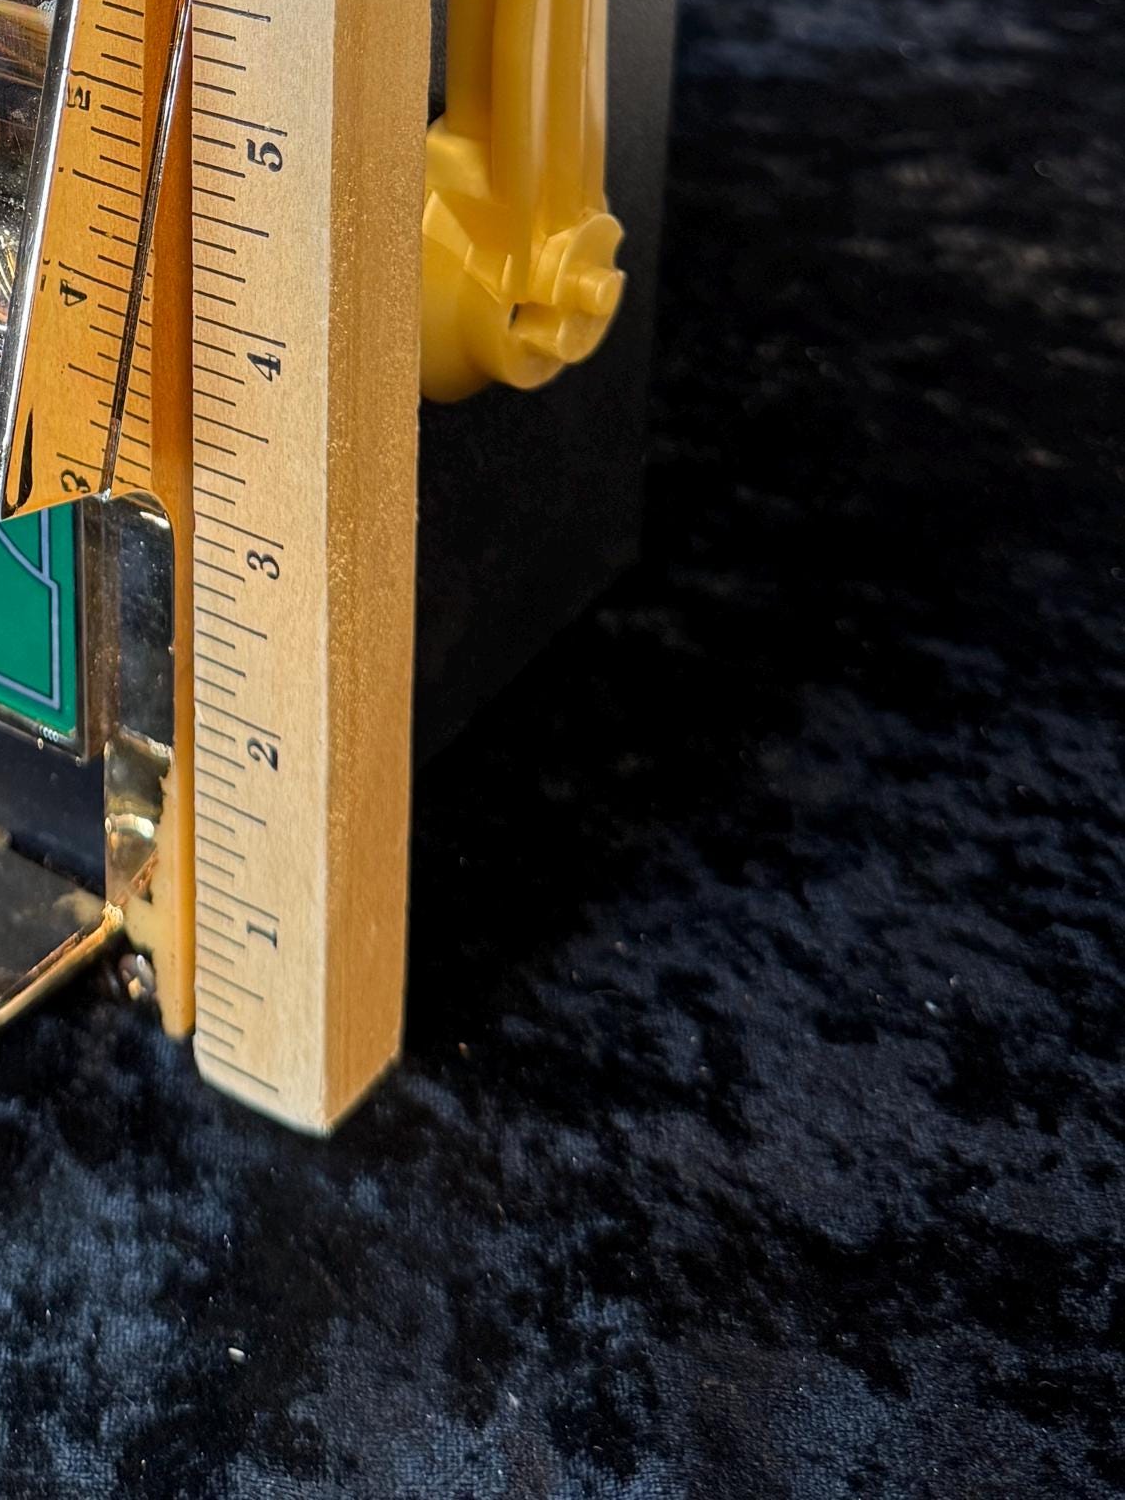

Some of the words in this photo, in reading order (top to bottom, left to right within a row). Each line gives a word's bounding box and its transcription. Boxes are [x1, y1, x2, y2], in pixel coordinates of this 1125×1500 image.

[246, 137, 284, 173] 5
[246, 352, 282, 383] 4
[246, 549, 281, 581] 3
[246, 736, 280, 772] 2
[246, 920, 279, 950] 1
